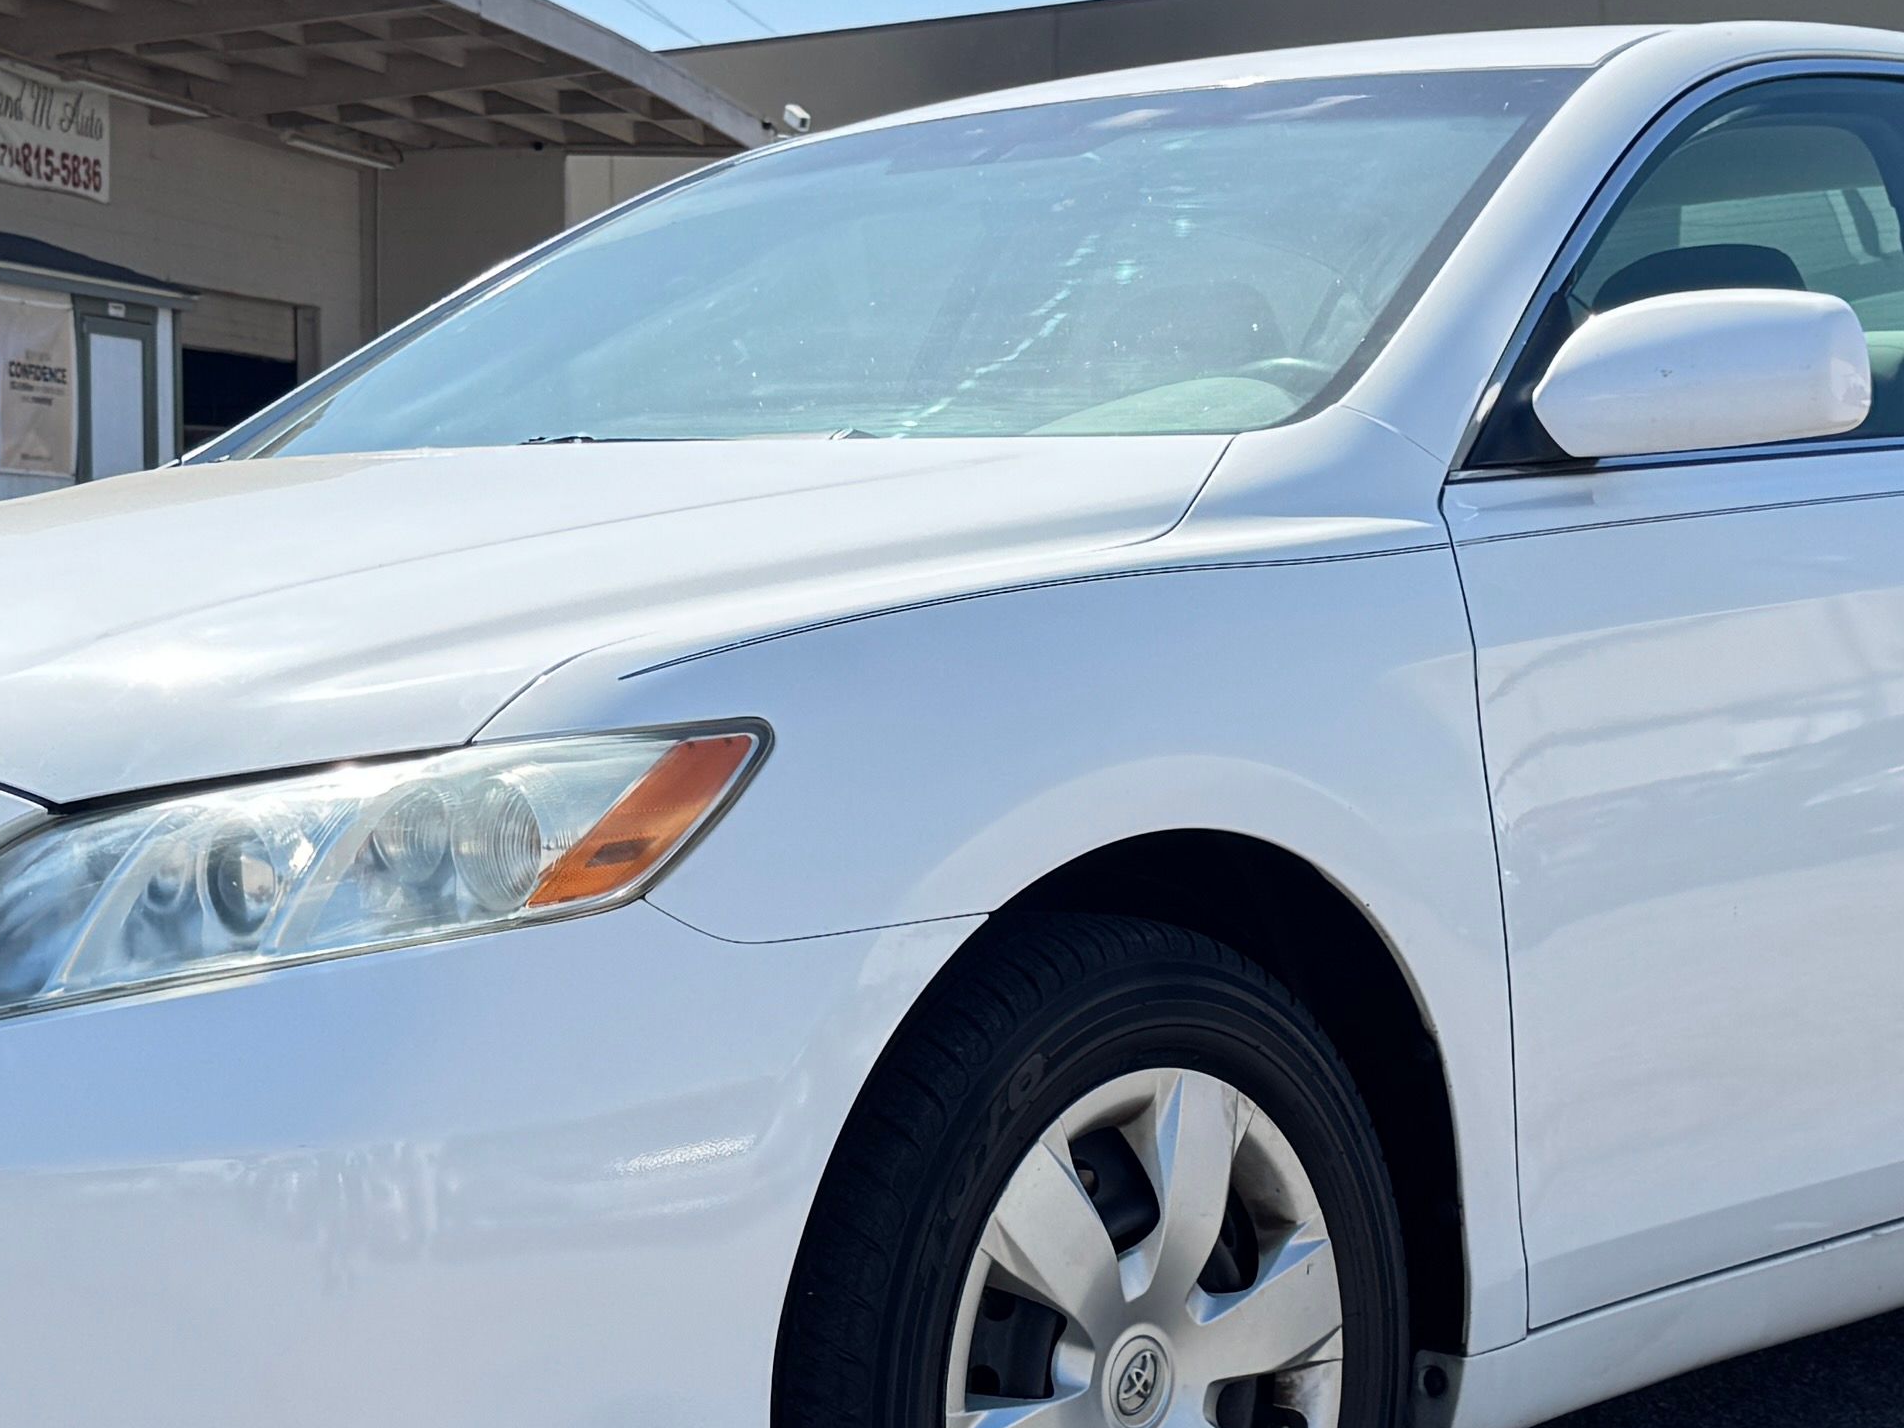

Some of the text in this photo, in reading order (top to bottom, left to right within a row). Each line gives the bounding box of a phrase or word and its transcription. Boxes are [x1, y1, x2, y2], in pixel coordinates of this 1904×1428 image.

[30, 80, 54, 130] M
[59, 89, 104, 141] Auto
[8, 360, 68, 385] CONFIDENCE
